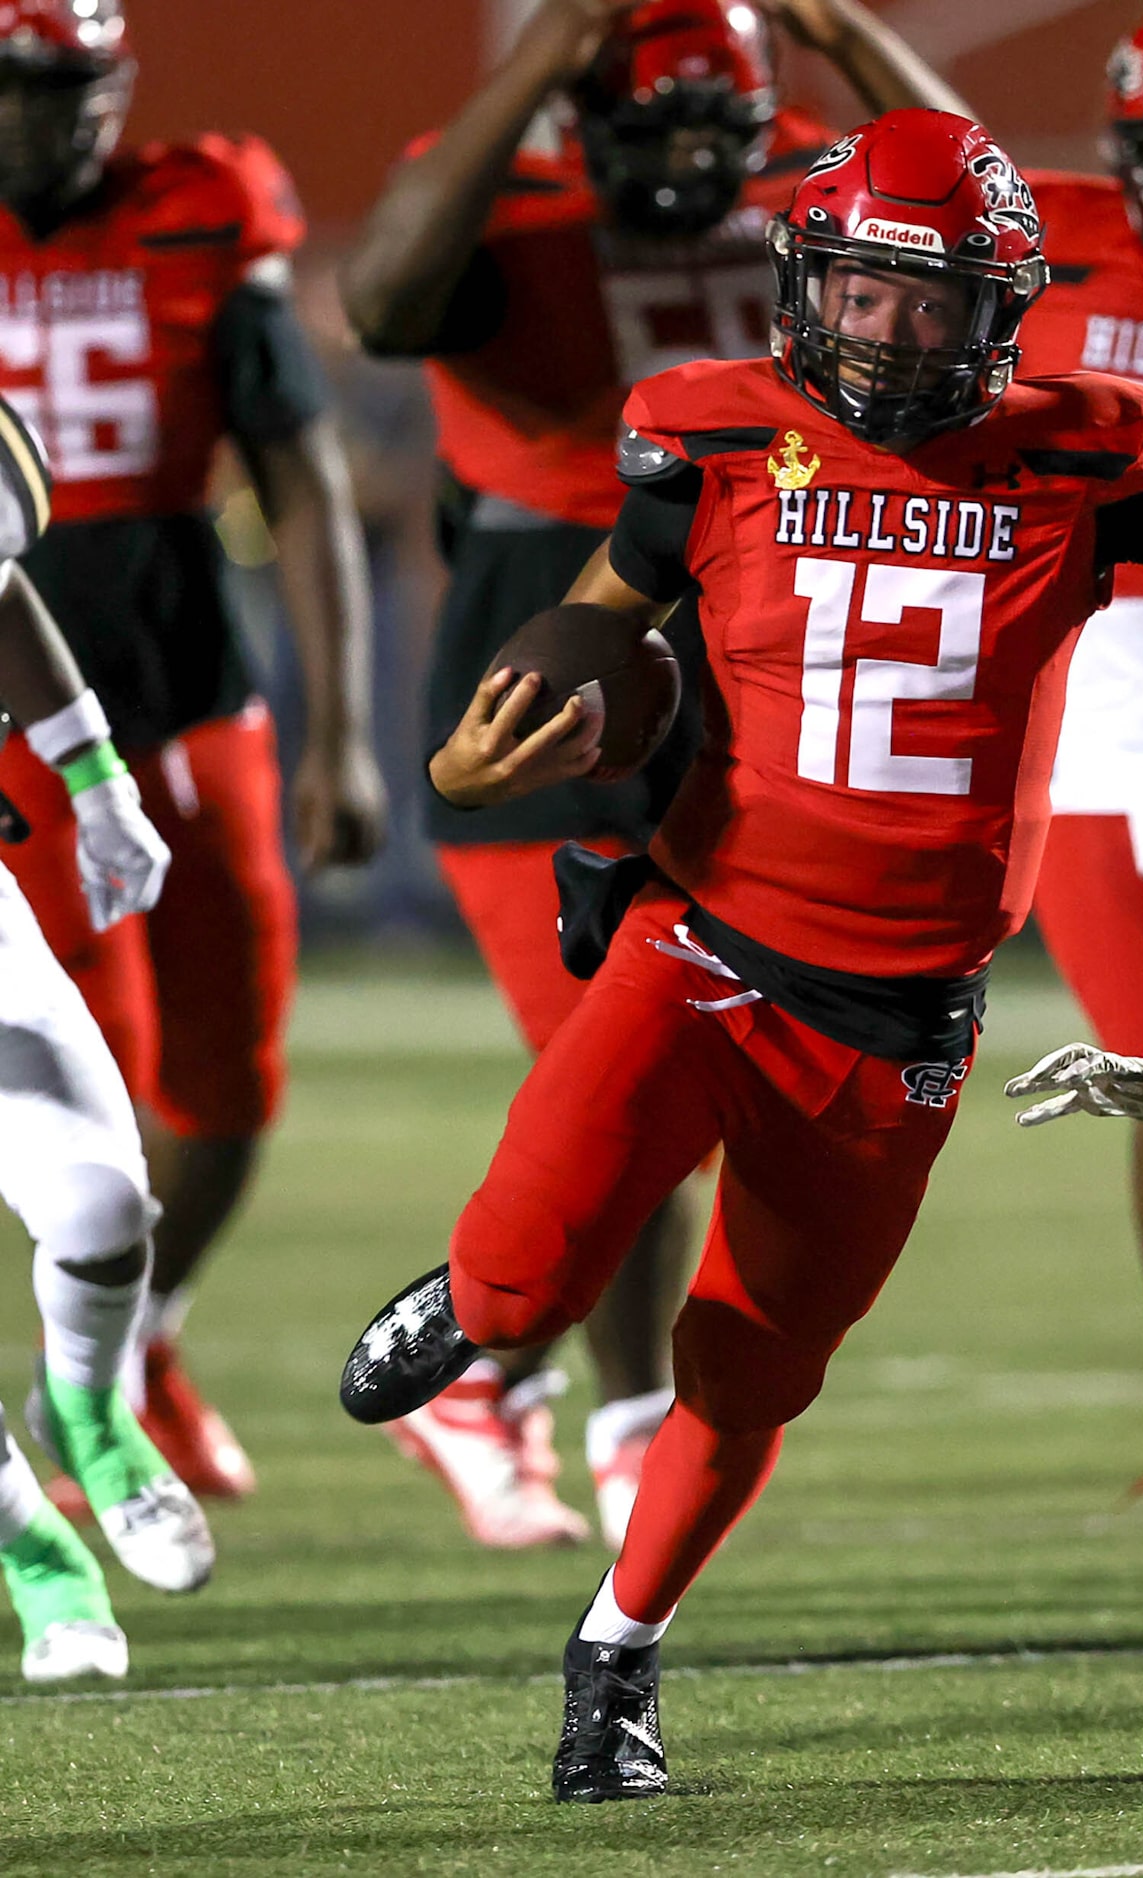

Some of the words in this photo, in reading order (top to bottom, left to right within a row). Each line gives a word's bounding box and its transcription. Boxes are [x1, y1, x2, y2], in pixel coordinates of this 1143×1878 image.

[866, 223, 935, 247] Riddell
[775, 488, 1020, 563] HILLSIDE
[793, 556, 987, 796] 12
